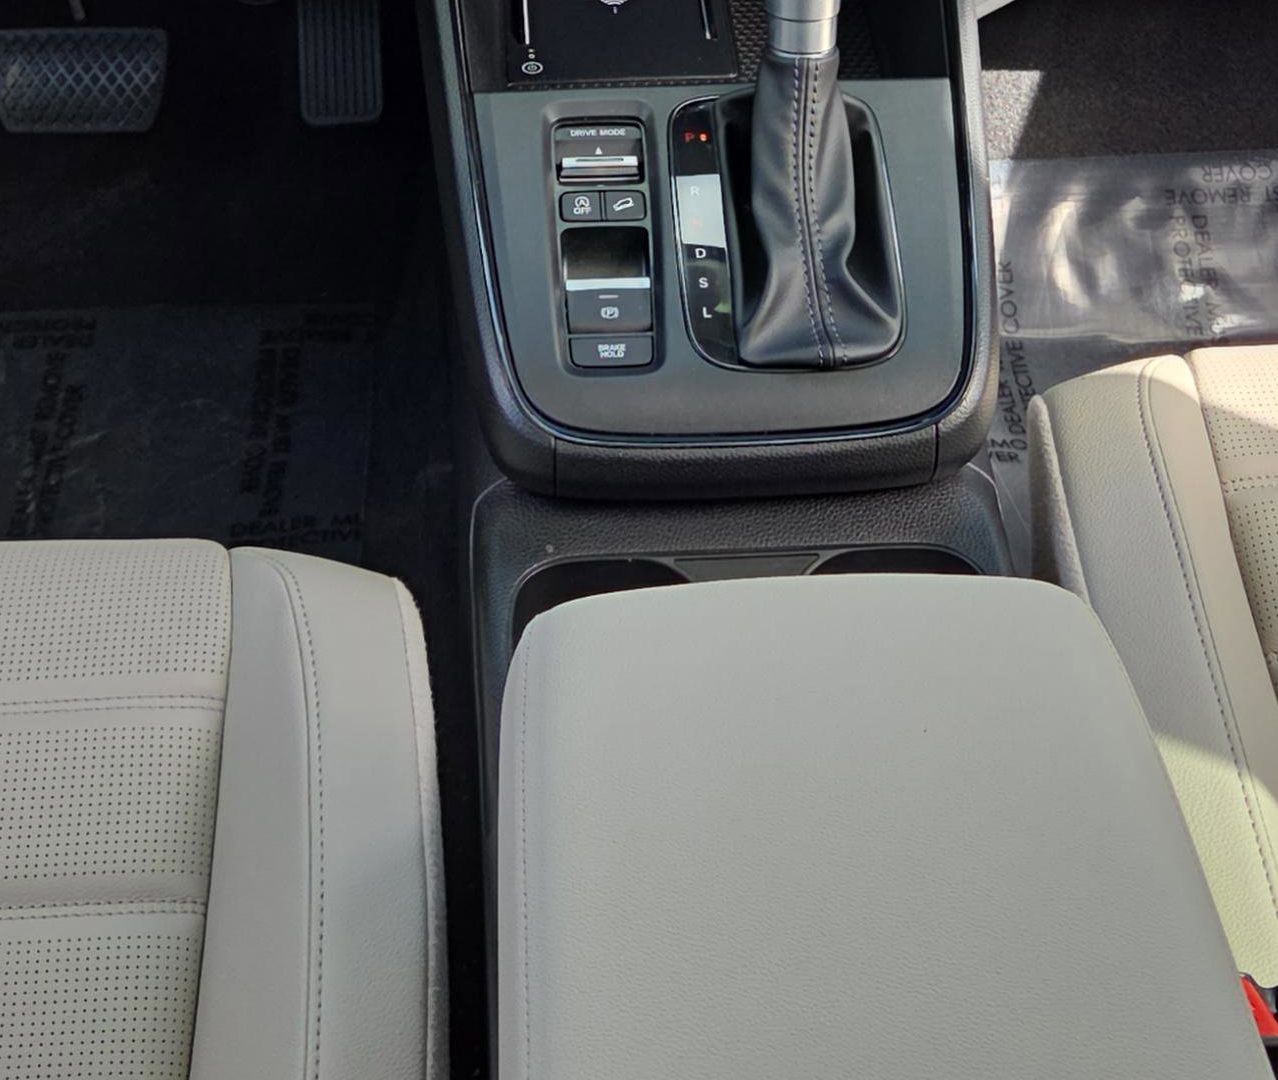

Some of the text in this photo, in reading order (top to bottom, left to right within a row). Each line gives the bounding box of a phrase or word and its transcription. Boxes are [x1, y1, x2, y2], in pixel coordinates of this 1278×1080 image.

[570, 128, 626, 137] DRIVE MODE
[685, 133, 695, 143] P
[690, 186, 699, 196] R
[1164, 186, 1250, 207] REMOVE
[573, 207, 592, 215] OFF
[695, 248, 707, 259] D
[699, 278, 709, 288] S
[703, 308, 712, 318] L
[598, 344, 626, 352] BRAKE
